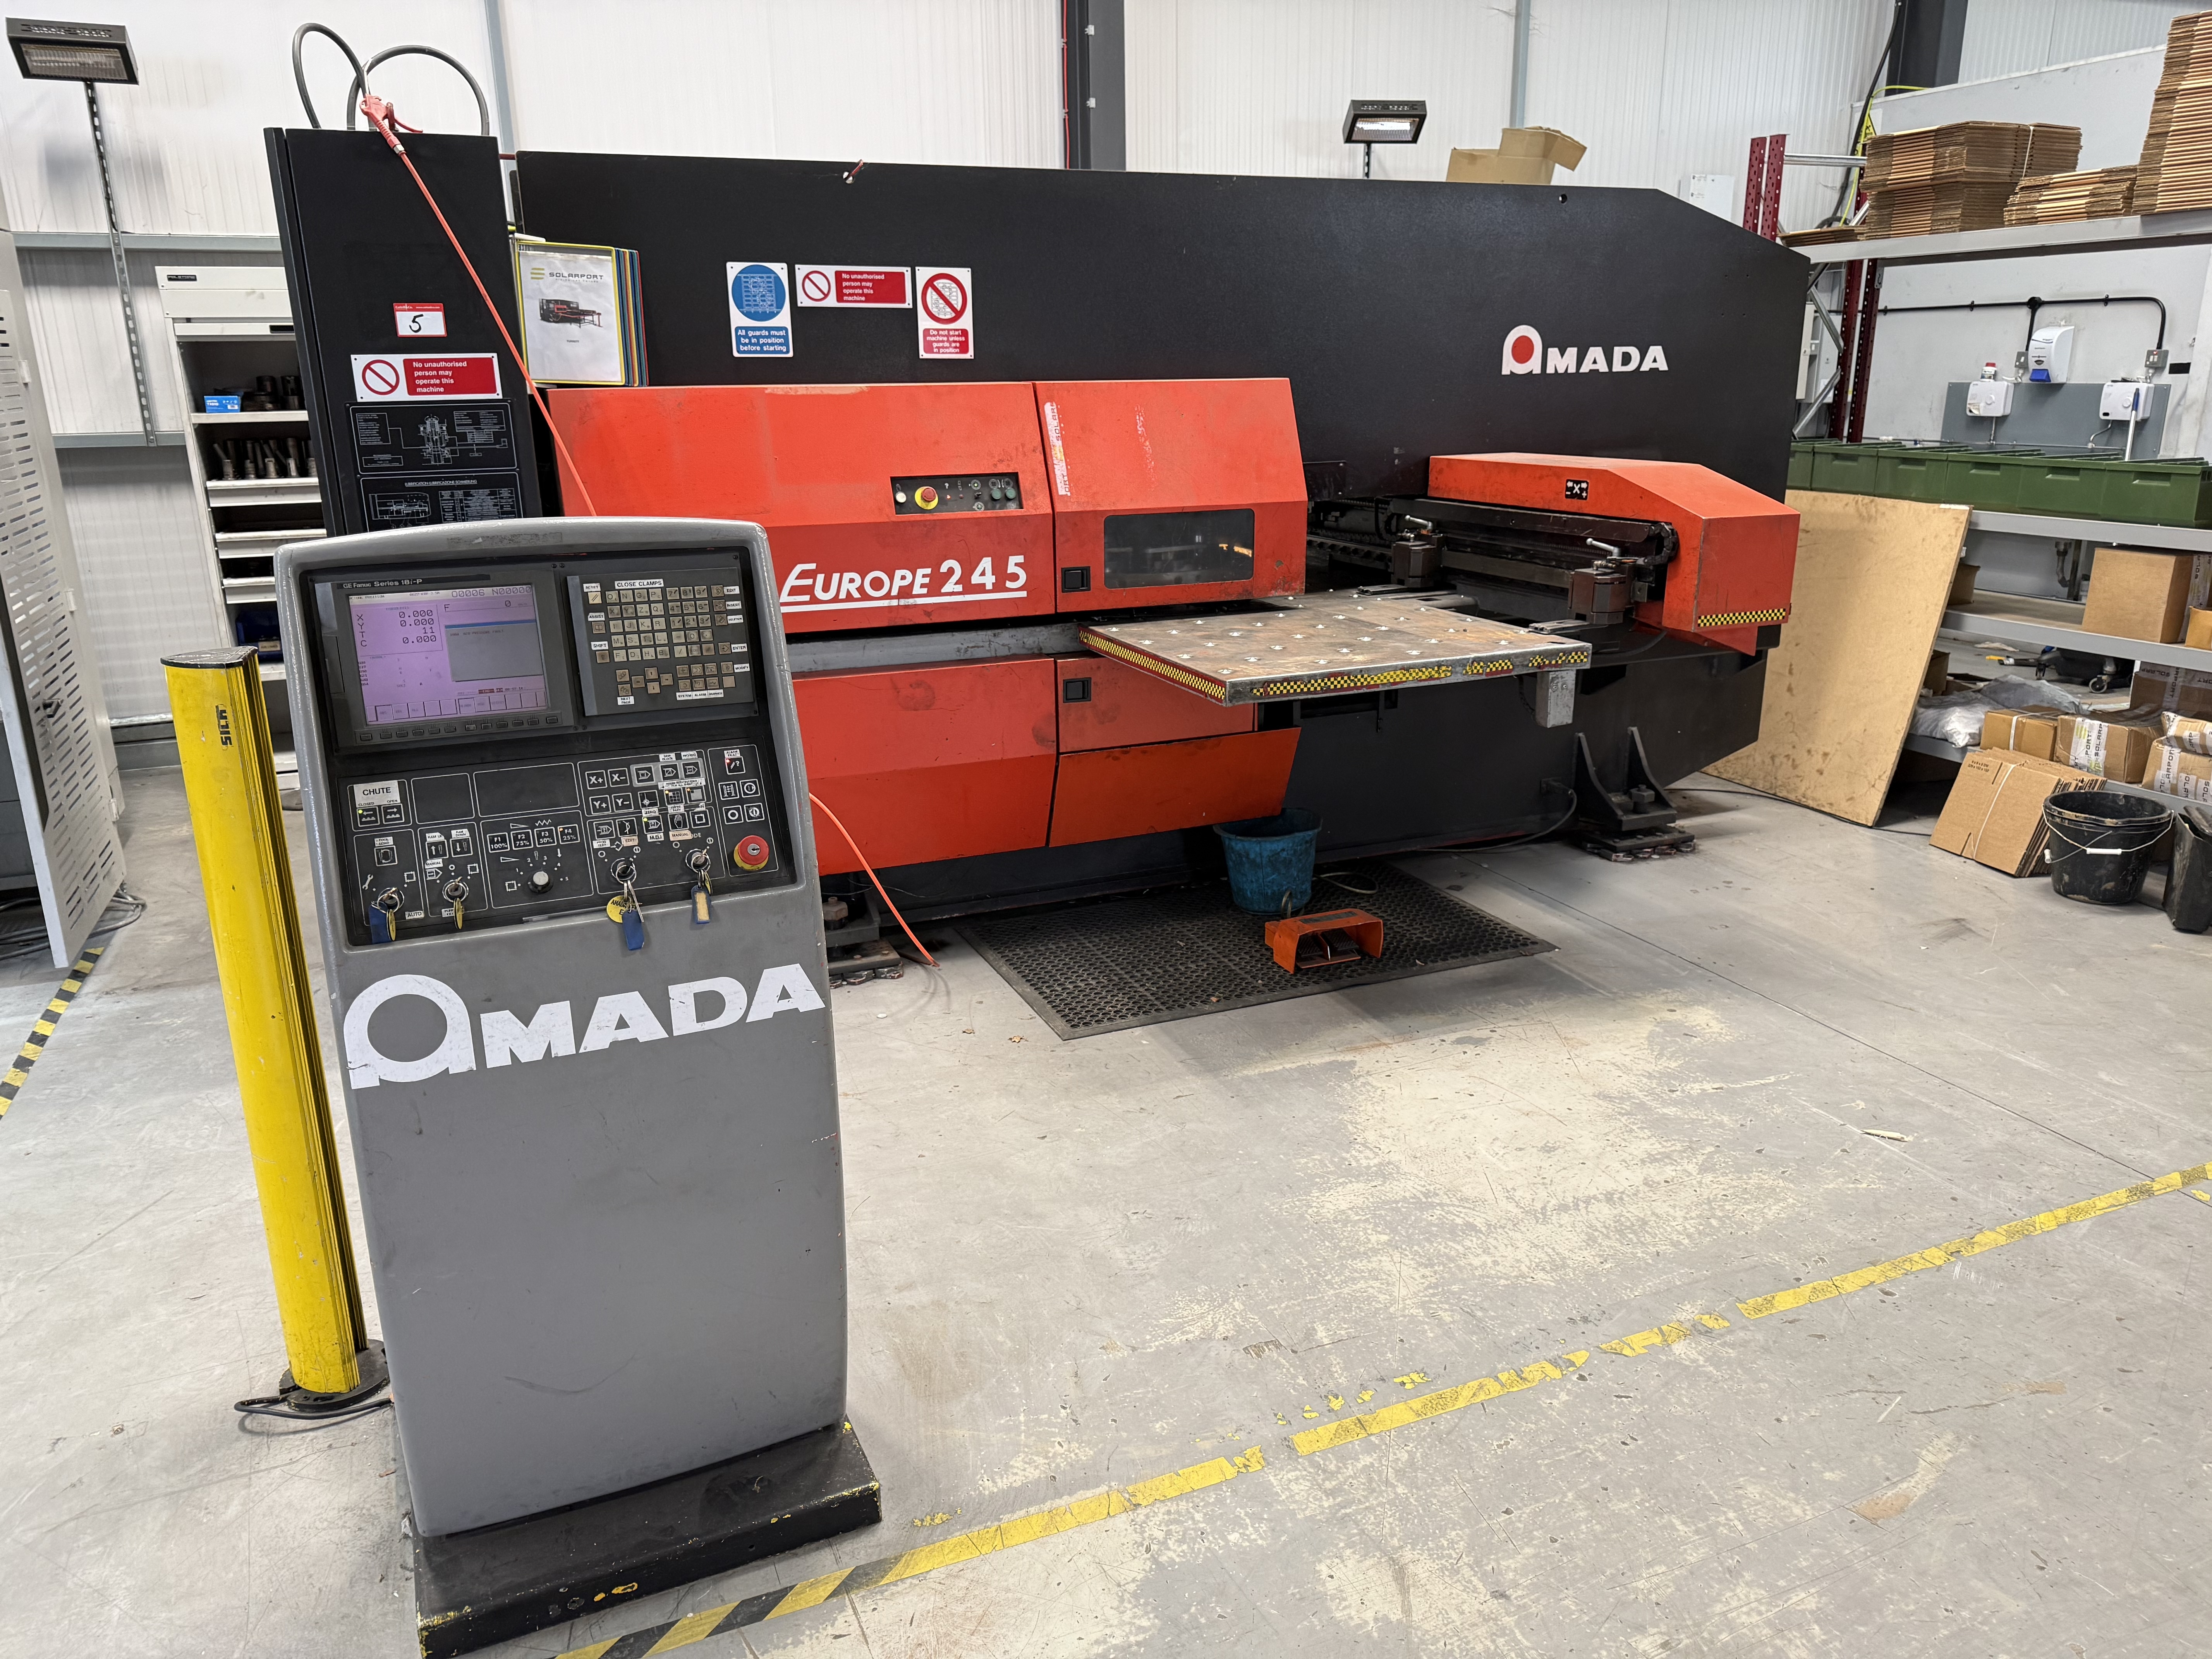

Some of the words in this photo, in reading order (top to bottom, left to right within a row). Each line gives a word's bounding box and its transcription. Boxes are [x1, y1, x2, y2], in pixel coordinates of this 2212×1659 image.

[409, 314, 424, 333] 5
[1501, 325, 1668, 375] AMADA
[779, 563, 931, 603] EUROPE
[399, 610, 433, 618] 0.000
[400, 618, 434, 627] 0.000
[402, 635, 436, 644] 0.000
[589, 776, 603, 784] X+
[362, 787, 391, 795] CHUTE
[343, 963, 826, 1089] AMADA
